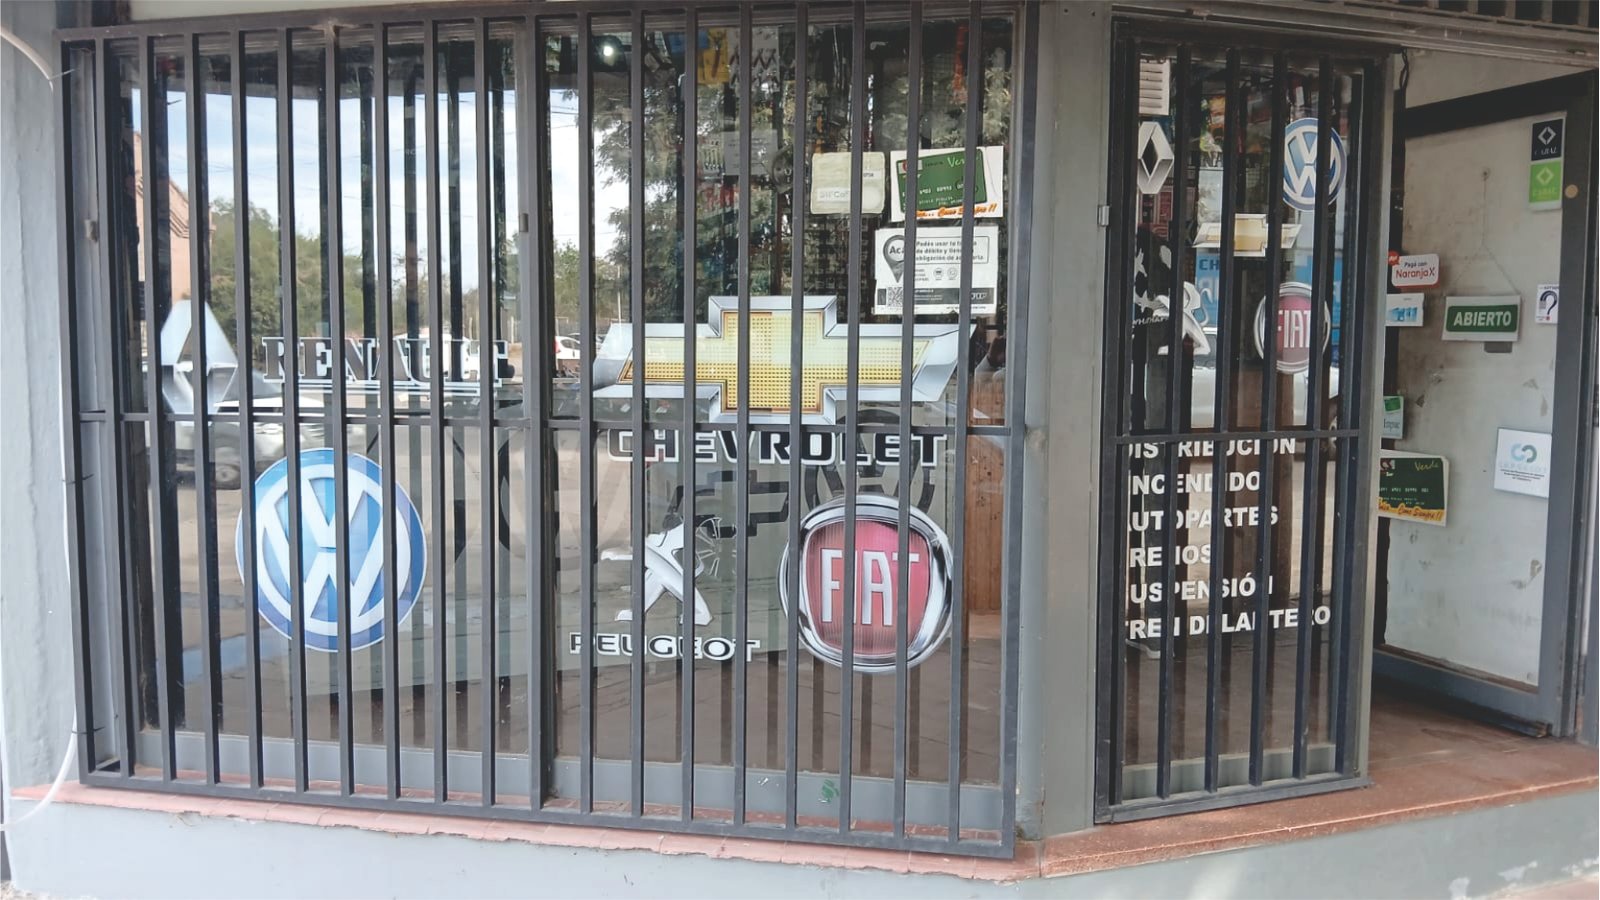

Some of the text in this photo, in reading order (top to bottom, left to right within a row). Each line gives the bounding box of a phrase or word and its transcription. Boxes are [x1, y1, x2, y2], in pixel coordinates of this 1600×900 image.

[947, 152, 981, 168] Ver
[889, 245, 905, 254] Ac
[1277, 309, 1312, 348] IAT
[1453, 310, 1512, 327] ABIERTO
[1128, 437, 1296, 459] ISRIBUCIN
[1129, 471, 1261, 496] NCENDDO
[1127, 506, 1279, 532] UTOPARTES
[1129, 545, 1212, 568] REOS
[820, 548, 920, 627] FAT
[1129, 572, 1274, 604] USENSIÓ
[1125, 606, 1331, 640] RE DLATEO
